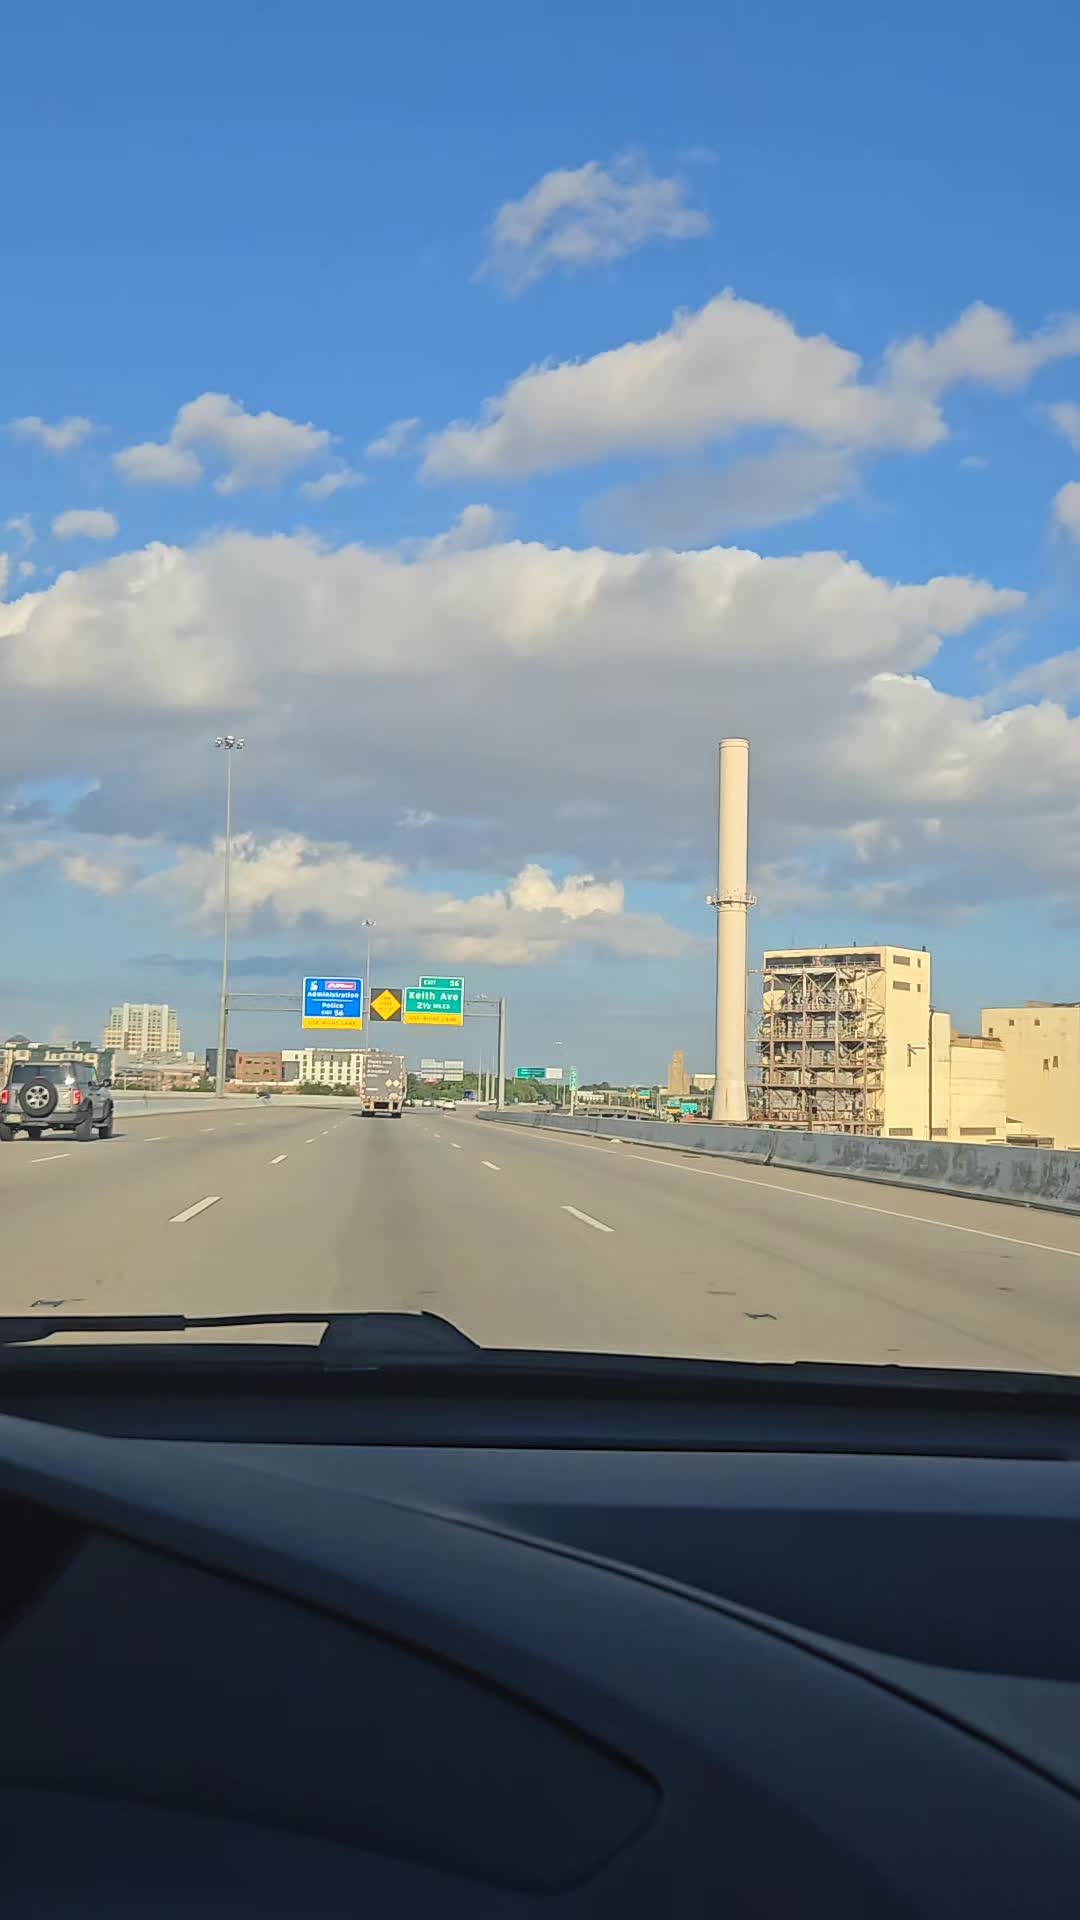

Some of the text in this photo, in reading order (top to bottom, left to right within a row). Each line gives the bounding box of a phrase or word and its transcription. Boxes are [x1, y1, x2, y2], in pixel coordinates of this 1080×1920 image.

[307, 991, 359, 999] Administration
[408, 991, 459, 1001] Keith Ave
